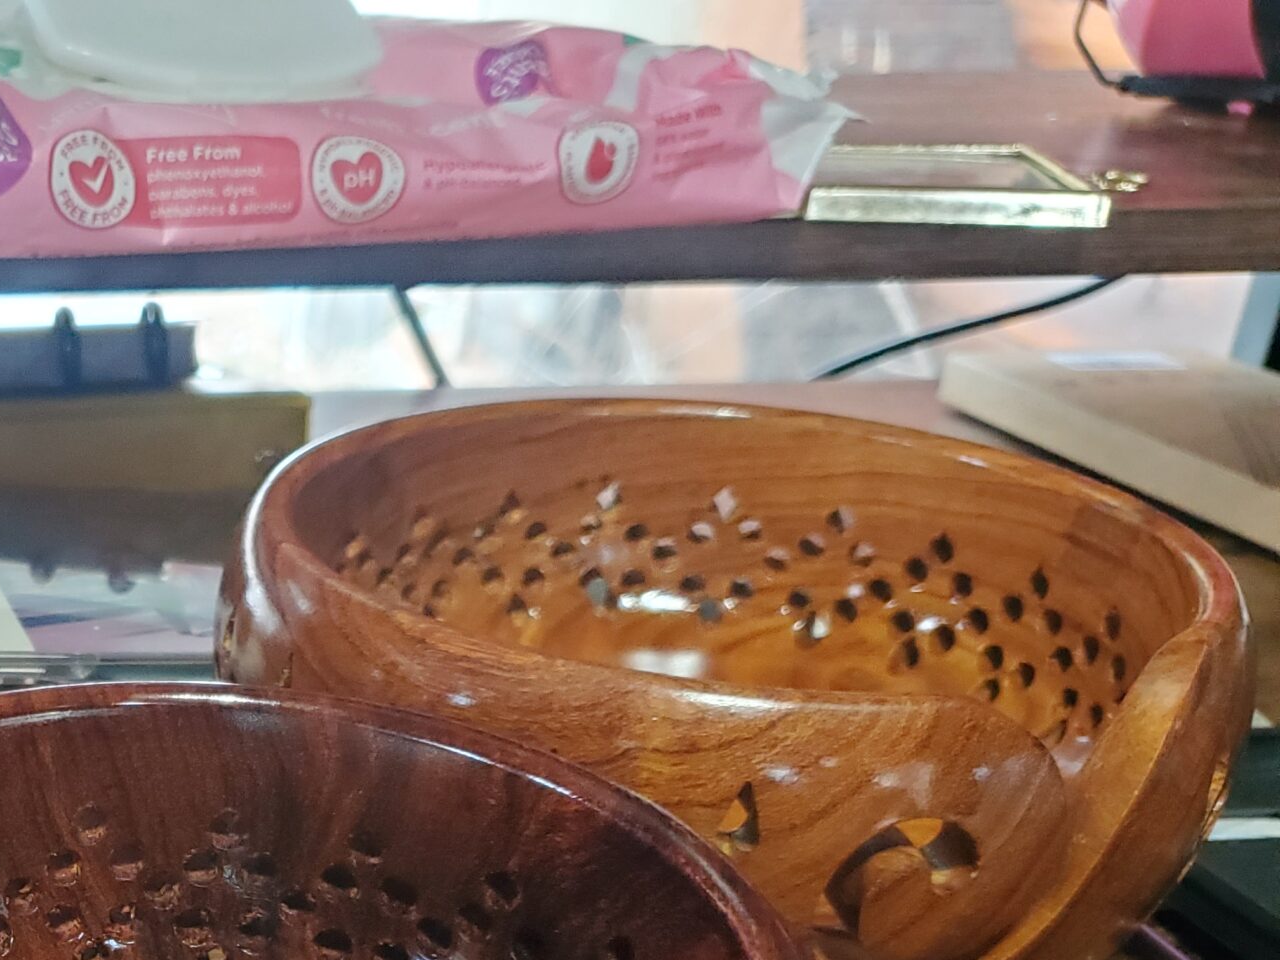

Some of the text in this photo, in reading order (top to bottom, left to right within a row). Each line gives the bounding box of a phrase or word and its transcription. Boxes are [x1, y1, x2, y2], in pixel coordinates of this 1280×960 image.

[146, 145, 242, 164] Free From
[344, 168, 376, 192] pH
[59, 189, 128, 225] FREE FROM
